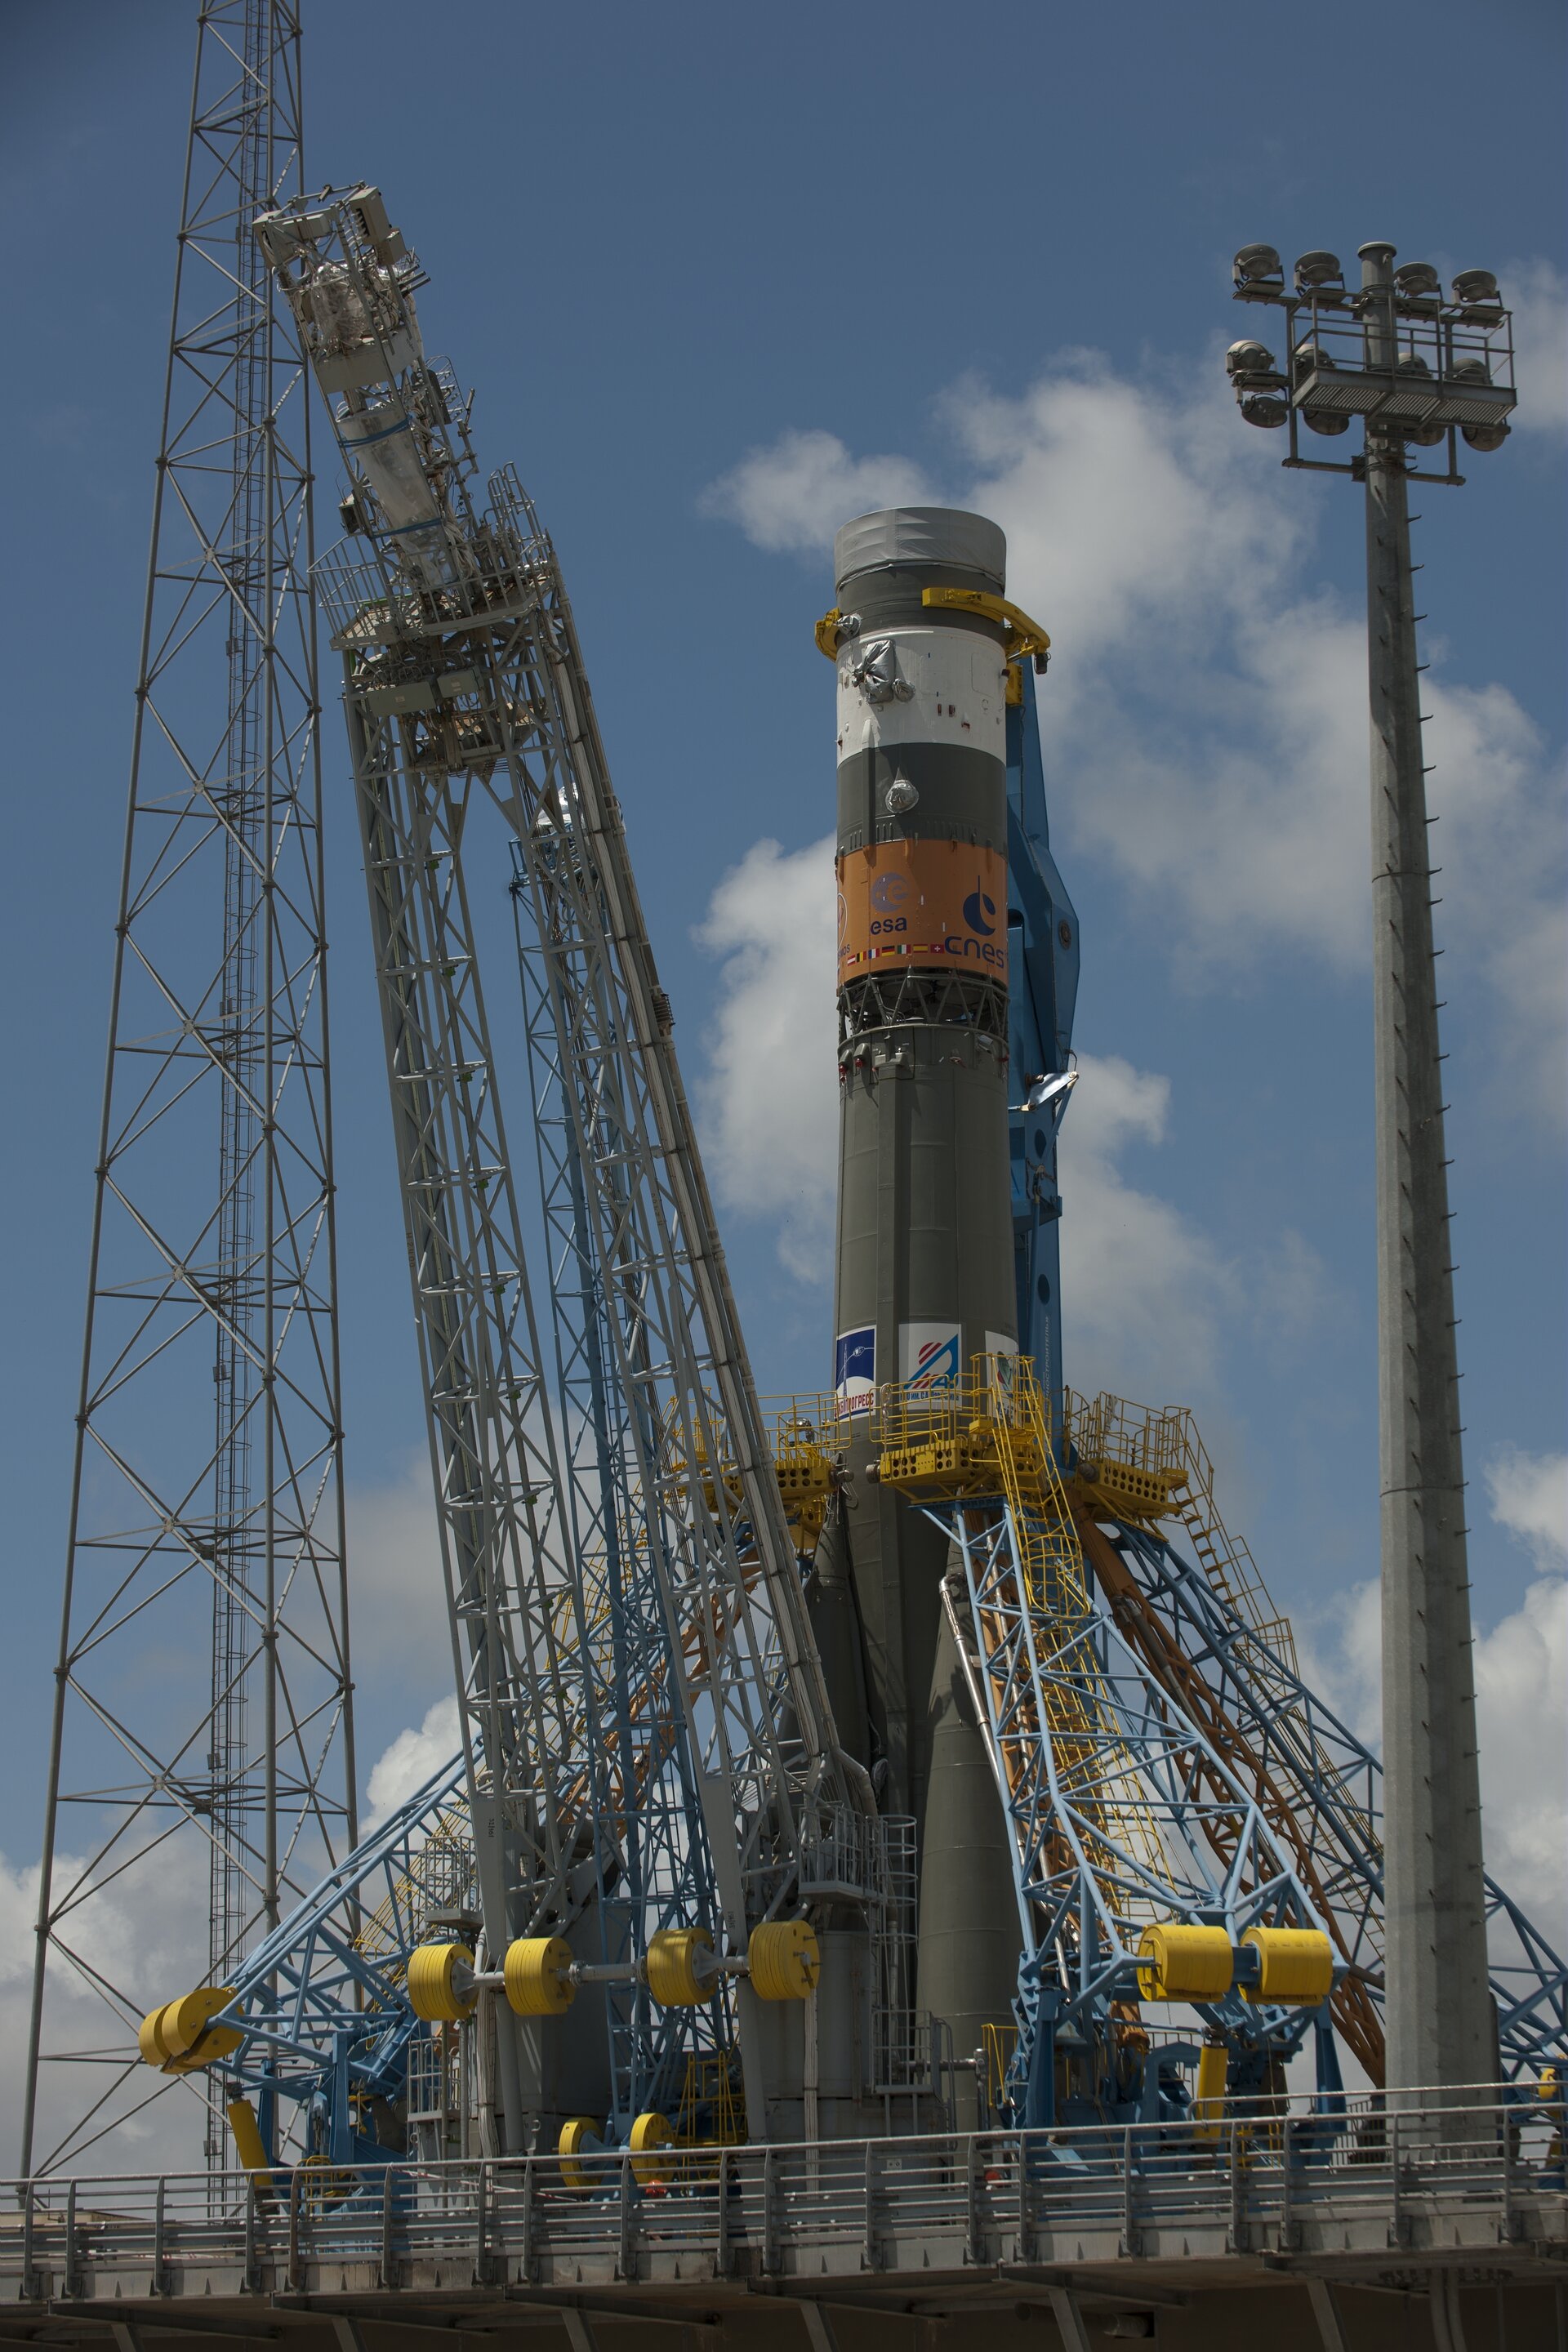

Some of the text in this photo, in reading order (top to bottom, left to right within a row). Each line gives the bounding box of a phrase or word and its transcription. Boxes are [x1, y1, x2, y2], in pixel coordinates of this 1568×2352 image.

[870, 917, 907, 935] esa
[944, 936, 1004, 969] cnes
[844, 1392, 874, 1413] ПОГРЕСС
